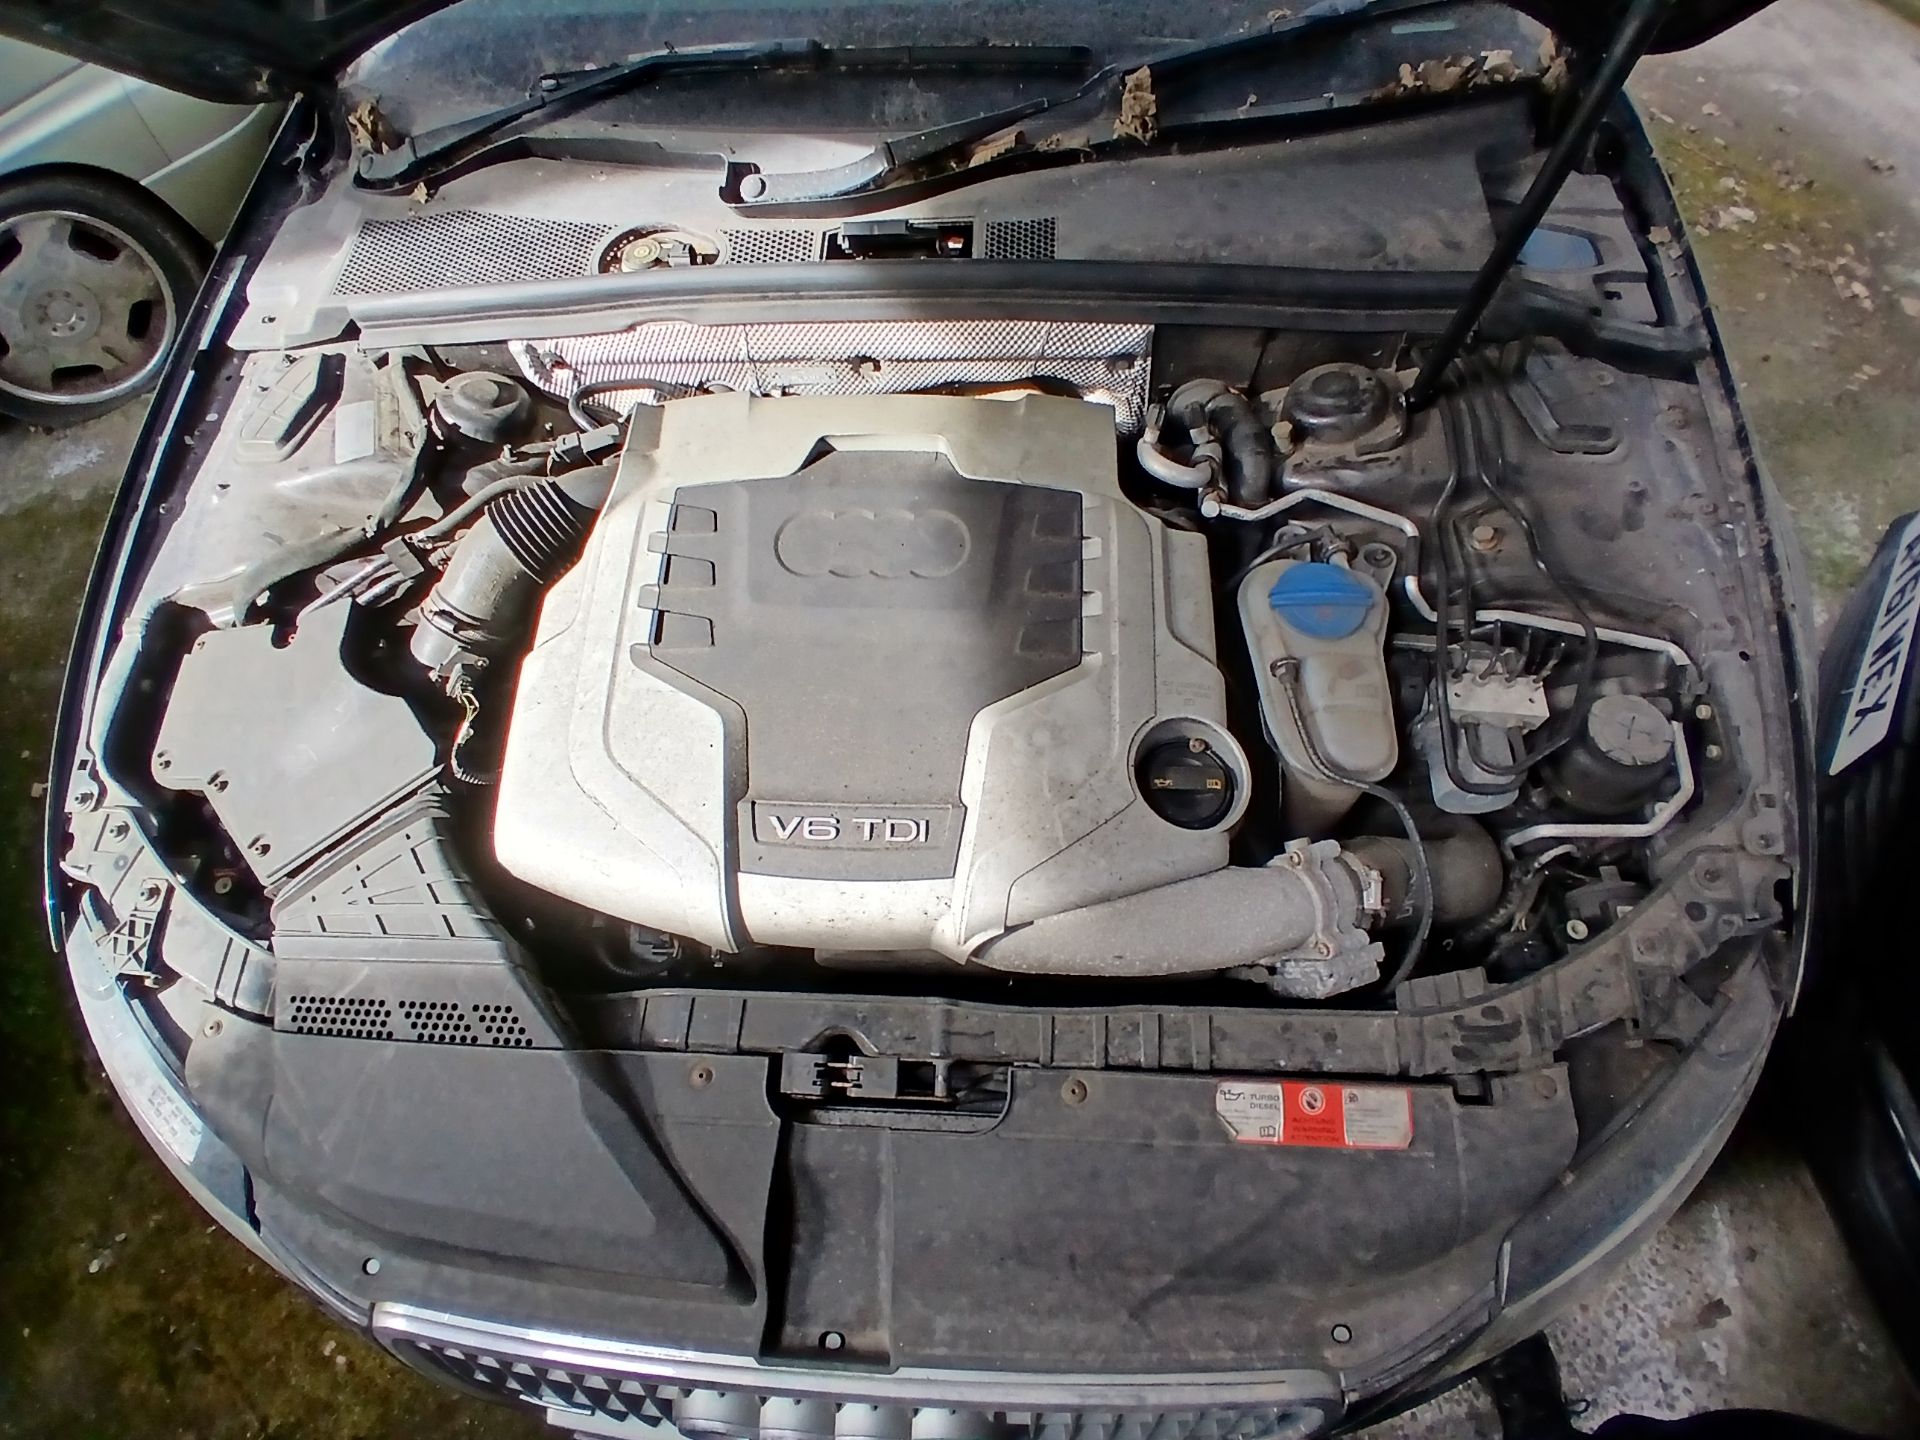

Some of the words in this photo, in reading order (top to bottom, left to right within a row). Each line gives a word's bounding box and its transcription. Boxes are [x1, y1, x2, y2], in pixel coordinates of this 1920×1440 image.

[1848, 618, 1910, 736] WEX
[768, 815, 840, 840] V6
[852, 817, 930, 843] TDI
[1249, 1093, 1280, 1101] TURBO
[1249, 1102, 1281, 1110] DIESEL
